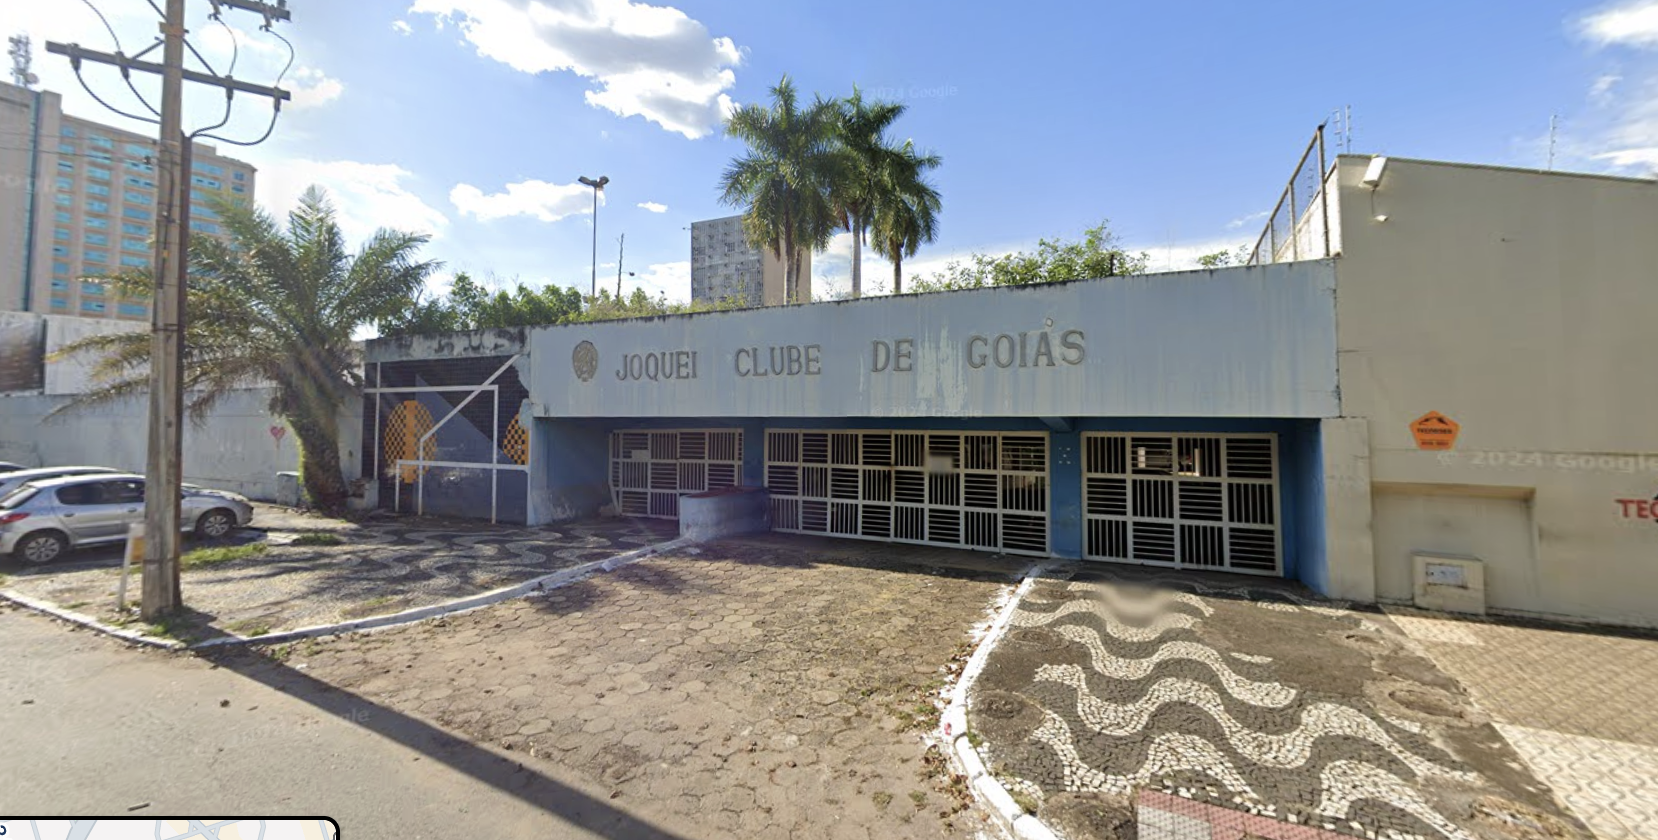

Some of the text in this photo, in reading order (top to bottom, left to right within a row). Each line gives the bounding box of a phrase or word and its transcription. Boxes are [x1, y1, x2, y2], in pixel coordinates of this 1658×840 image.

[615, 317, 1085, 381] JOQUEI CLUBE DE GOIÁS
